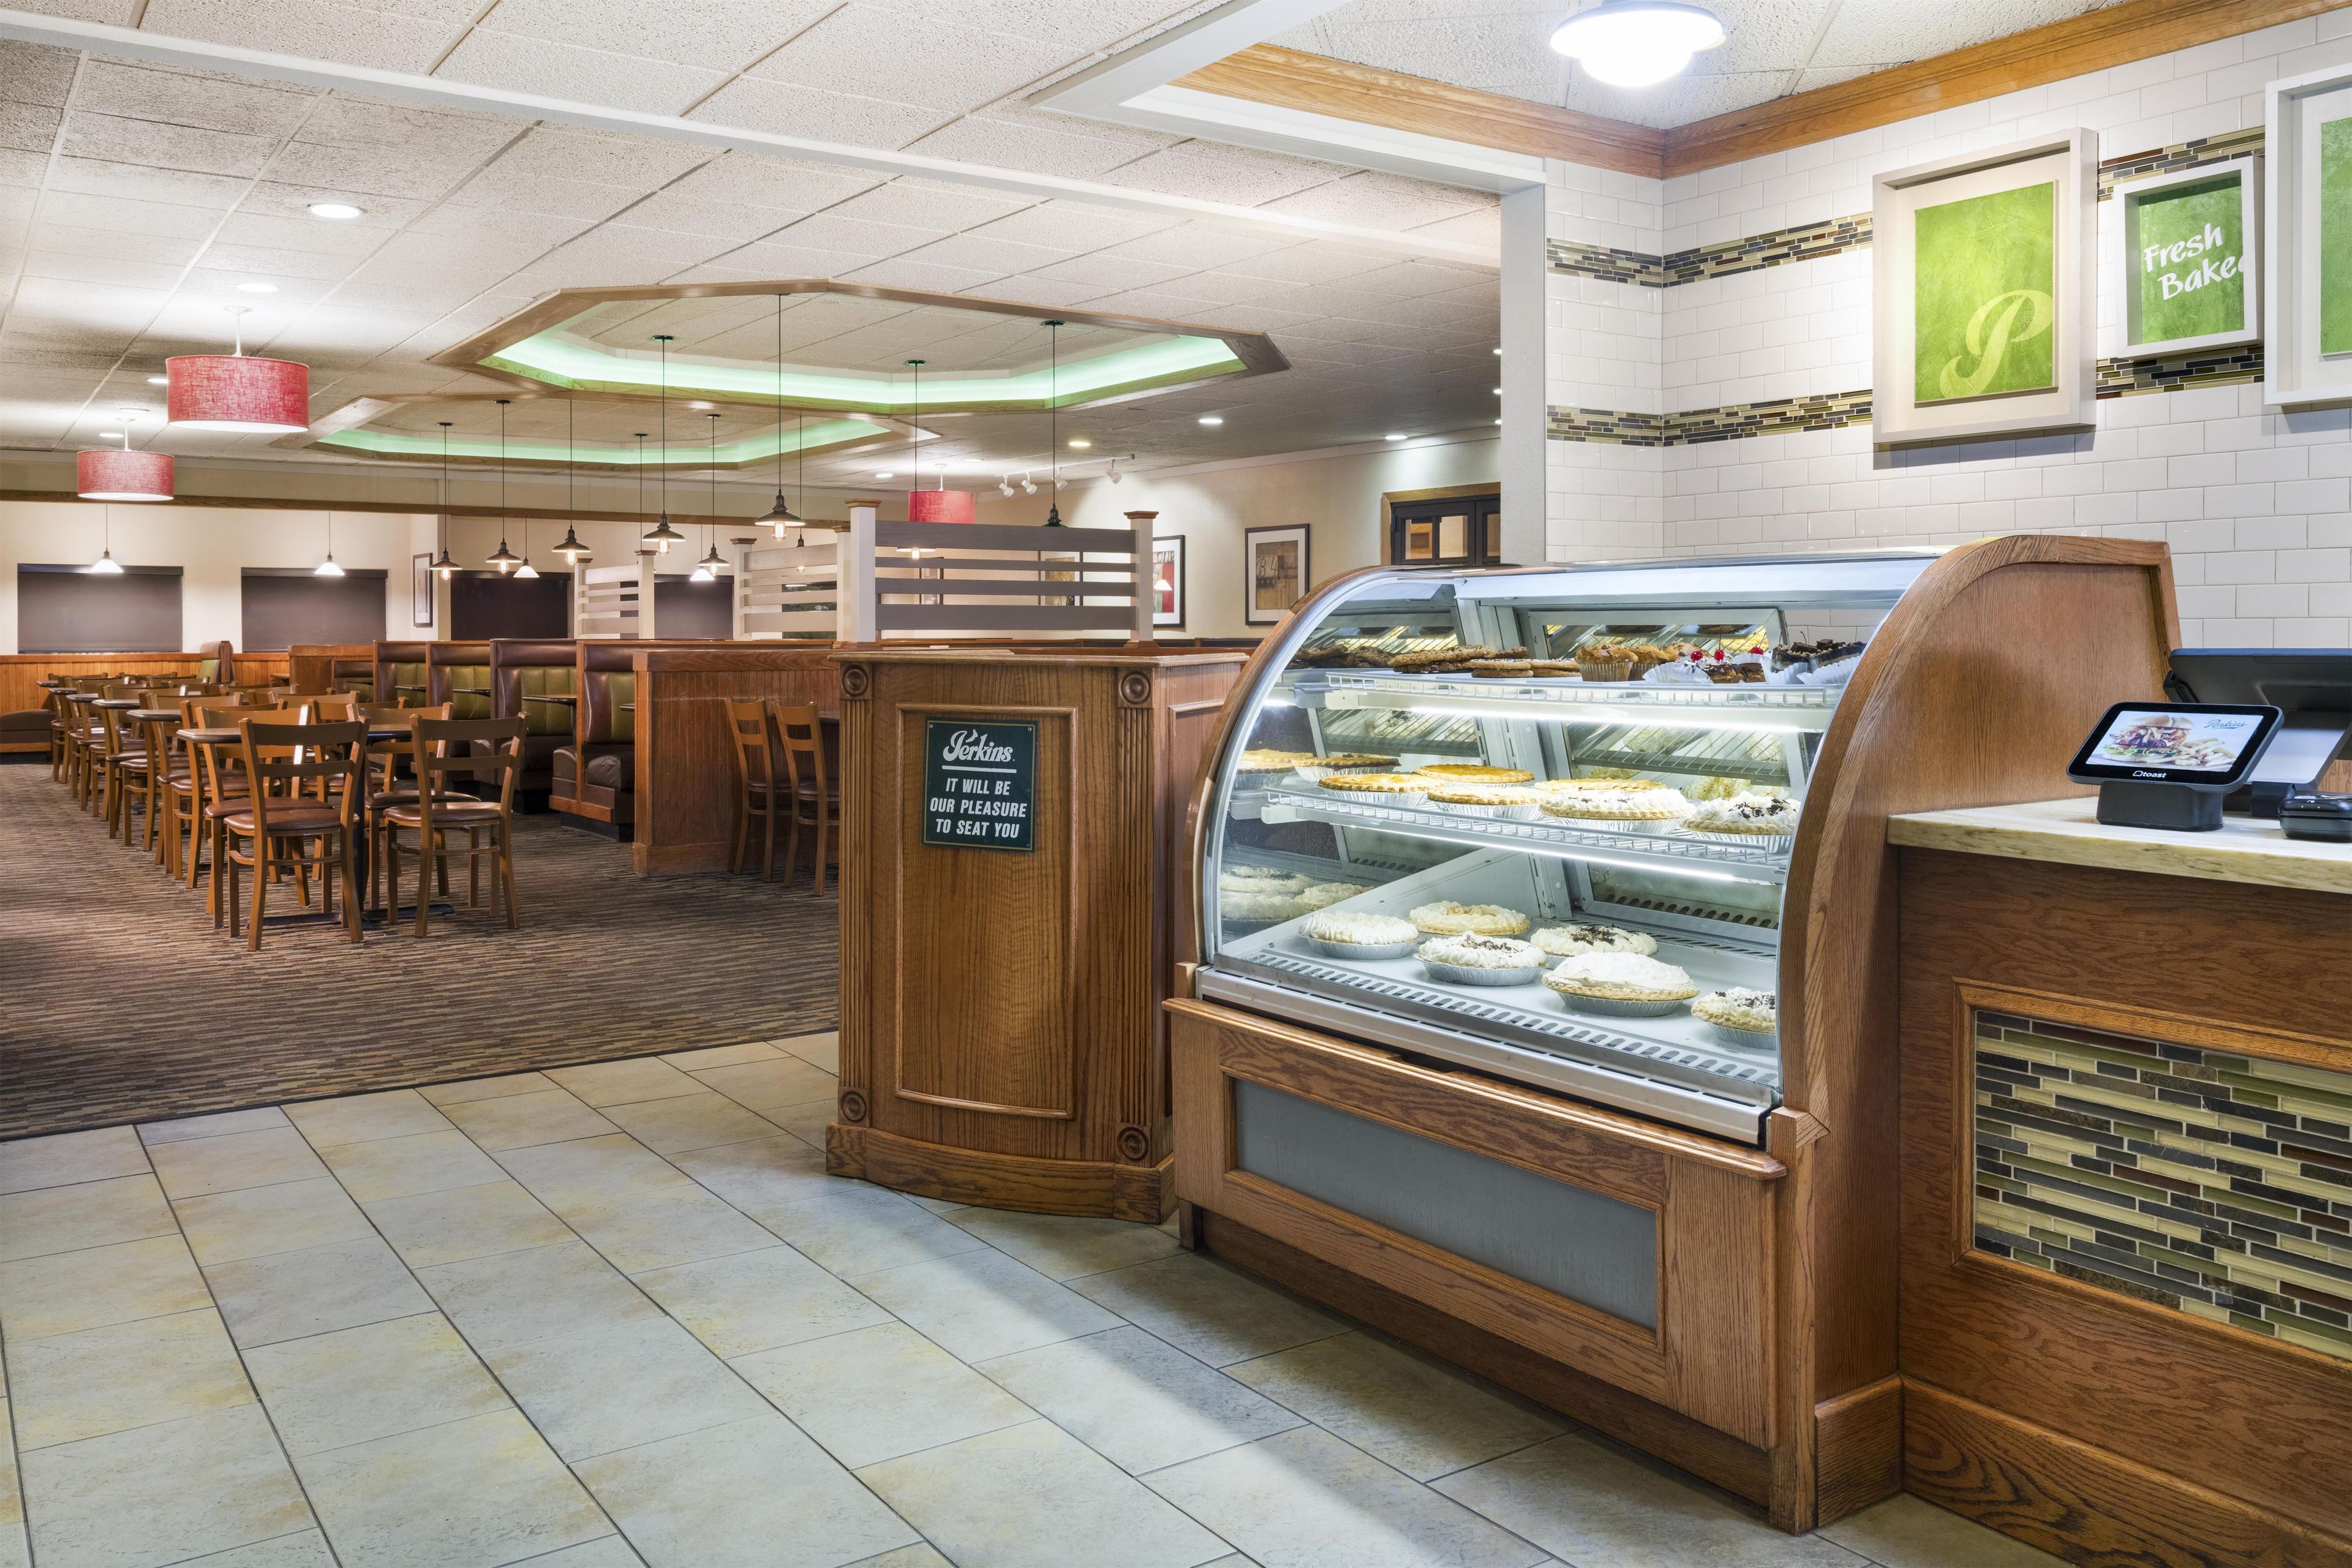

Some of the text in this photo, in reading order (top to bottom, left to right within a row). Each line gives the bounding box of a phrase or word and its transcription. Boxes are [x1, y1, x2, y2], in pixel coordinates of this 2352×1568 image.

[2143, 223, 2223, 273] Fresh
[2204, 719, 2247, 728] Perkins
[946, 778, 1011, 796] IT WILL BE
[930, 797, 1028, 818] OUR PLEASURE
[936, 818, 1020, 839] TO SEAT YOU
